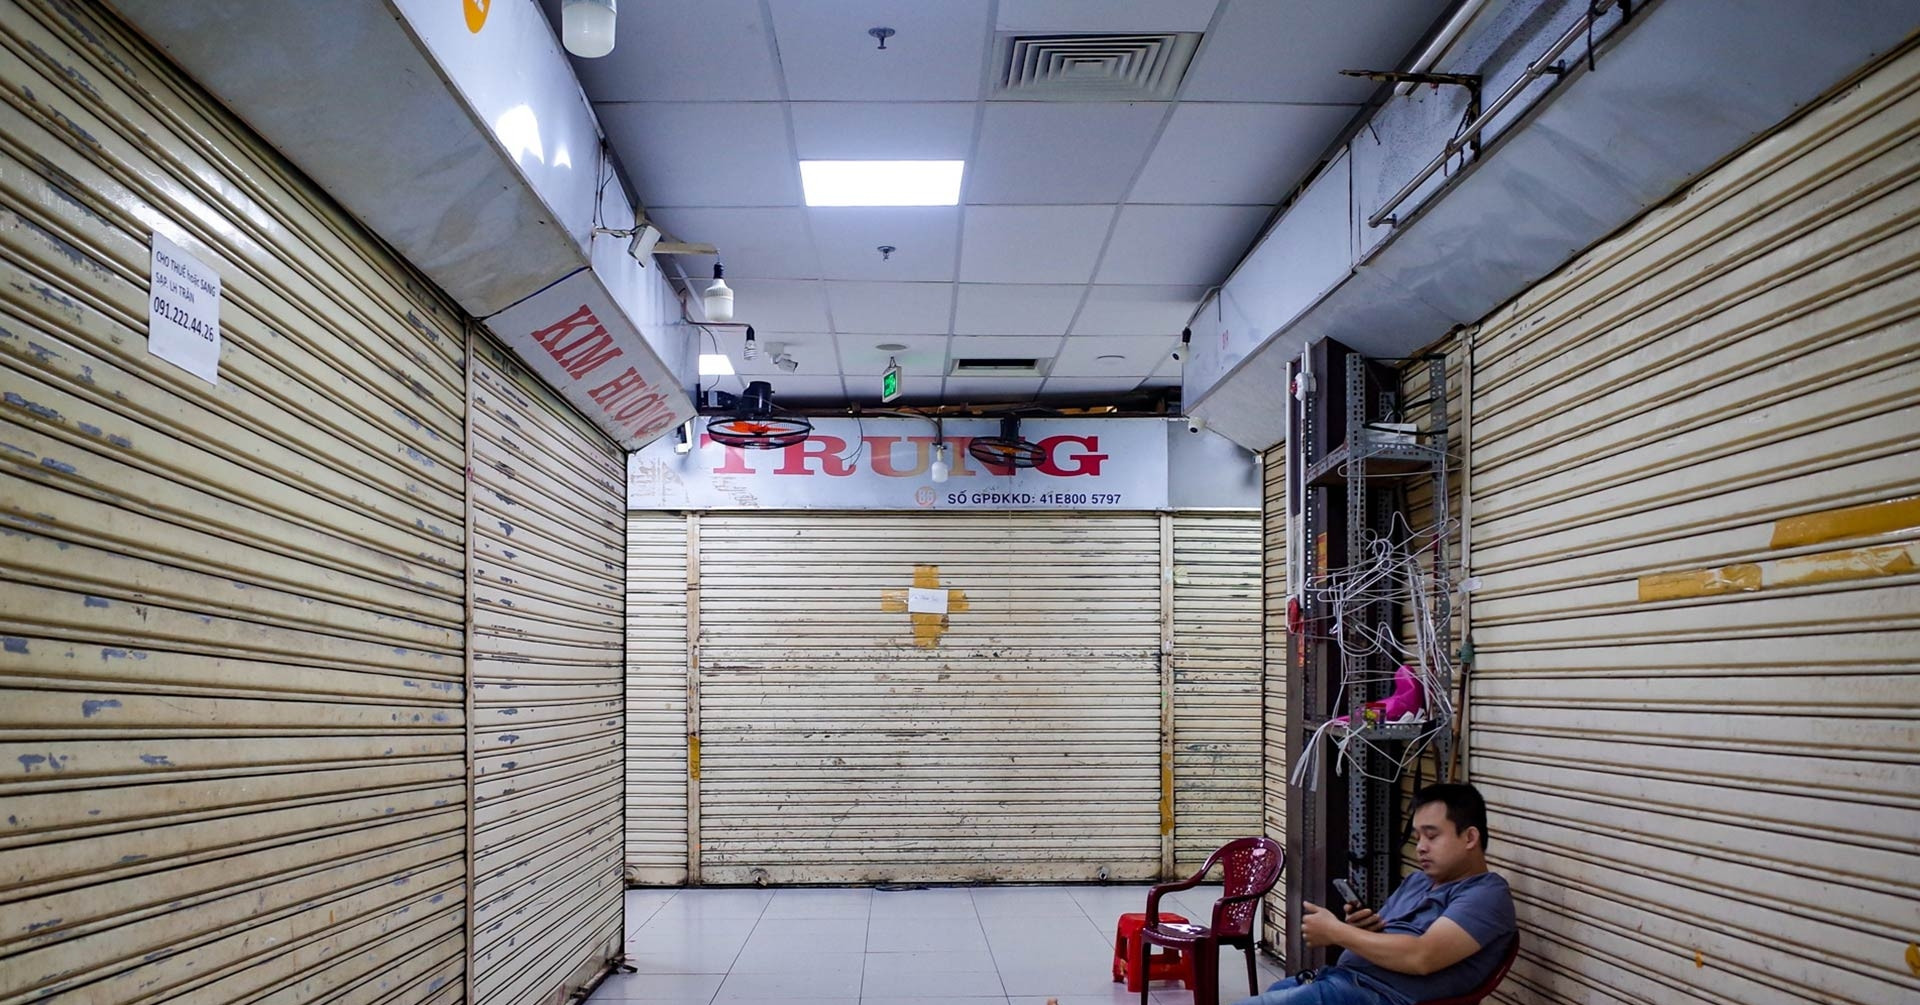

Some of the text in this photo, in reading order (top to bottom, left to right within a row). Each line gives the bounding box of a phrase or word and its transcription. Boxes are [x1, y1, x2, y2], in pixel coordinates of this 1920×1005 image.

[155, 251, 170, 267] CHO
[200, 279, 216, 297] SANG
[169, 281, 178, 294] LH
[153, 296, 214, 343] 091.222.44.26
[530, 304, 624, 381] KIM
[700, 434, 1109, 477] TRUNG
[947, 490, 1121, 505] SỐ GPĐKKD: 41E800 5797
